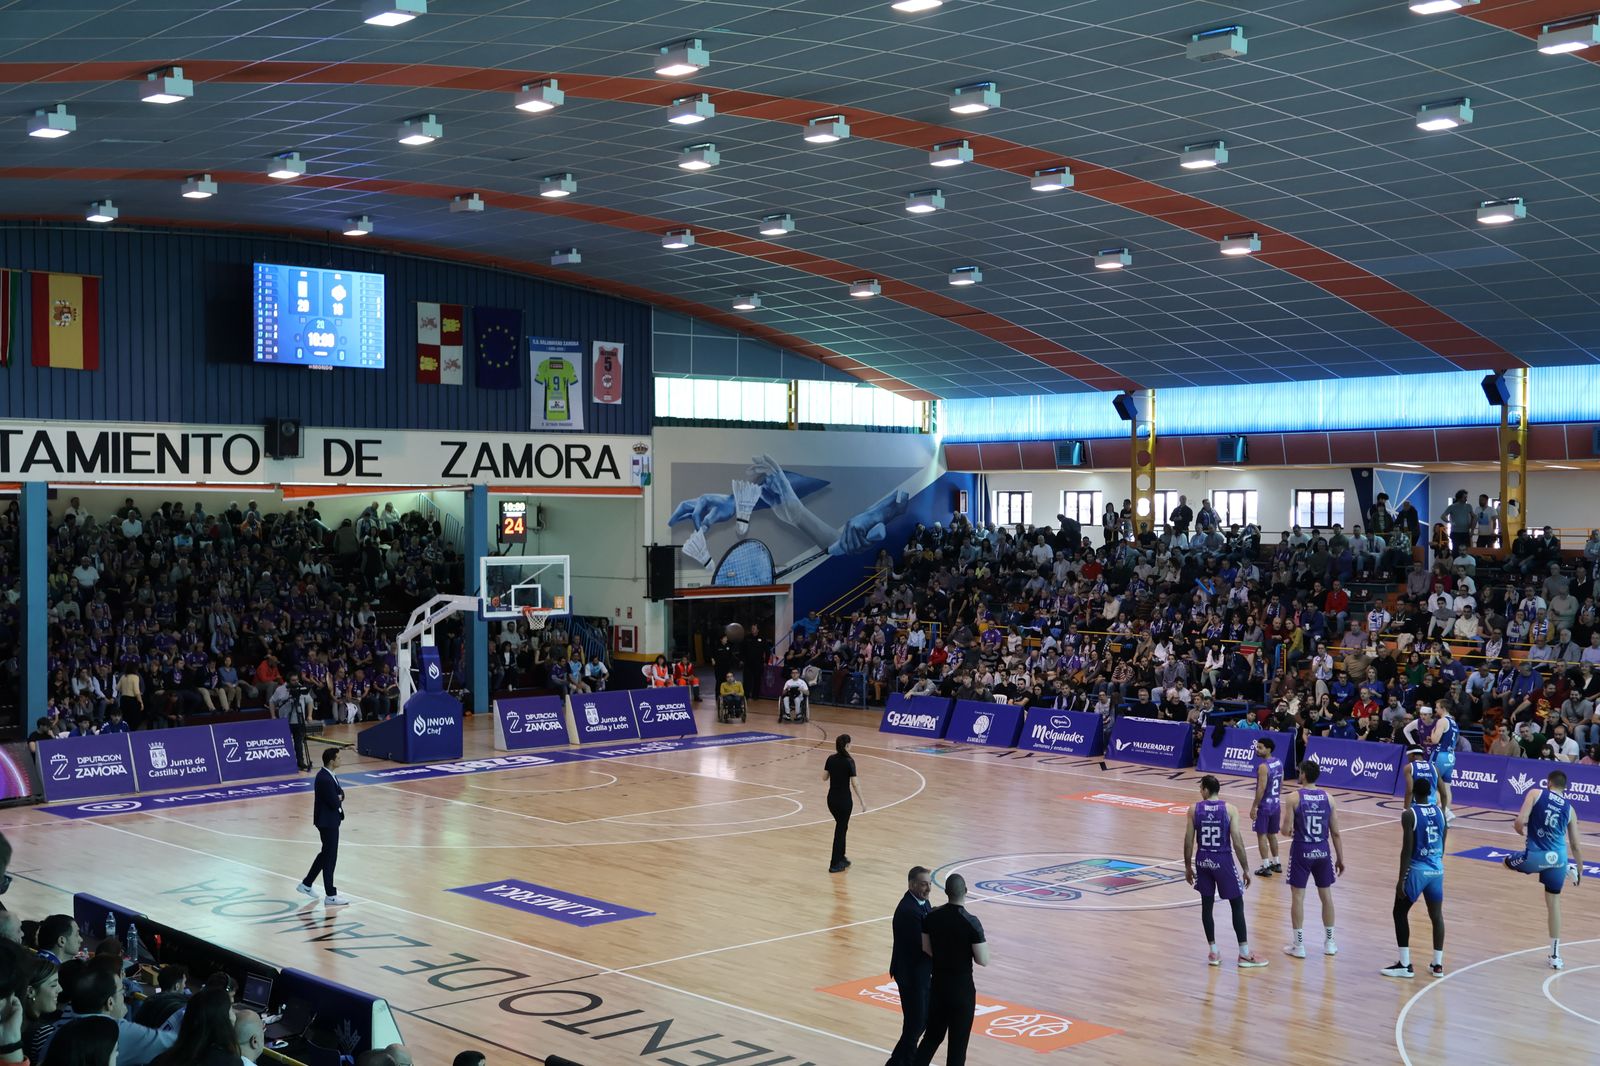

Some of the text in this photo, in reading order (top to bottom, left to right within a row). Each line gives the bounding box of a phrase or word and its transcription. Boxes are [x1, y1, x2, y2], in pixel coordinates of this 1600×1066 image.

[604, 356, 613, 371] 5
[553, 376, 560, 391] 9
[323, 438, 382, 477] DE
[440, 441, 621, 479] ZAMORA
[504, 518, 524, 534] 24
[427, 717, 455, 727] INNOVA
[656, 711, 691, 722] ZAMORA
[427, 727, 441, 735] Chef
[525, 722, 563, 732] ZAMORA
[585, 724, 608, 732] Castilla
[1031, 724, 1085, 746] Melquiades
[77, 754, 122, 764] DIPUTACION
[245, 748, 290, 761] ZAMORA
[170, 759, 193, 767] Junta
[1320, 757, 1393, 772] INNOVA INNOVA
[75, 765, 127, 778] ZAMORA
[149, 768, 178, 777] Castilla
[187, 765, 207, 774] León
[1319, 766, 1379, 779] Chef Chef
[1461, 770, 1498, 783] RURAL
[1271, 779, 1280, 796] 2
[1450, 779, 1480, 790] AMORA
[1563, 792, 1590, 802] MORA
[1306, 815, 1323, 835] 15
[1544, 809, 1560, 828] 16
[1201, 826, 1221, 847] 22
[1425, 826, 1439, 843] 15
[483, 884, 617, 918] ALIMERKA
[159, 878, 433, 960] ZAMORA
[379, 952, 531, 993] DE
